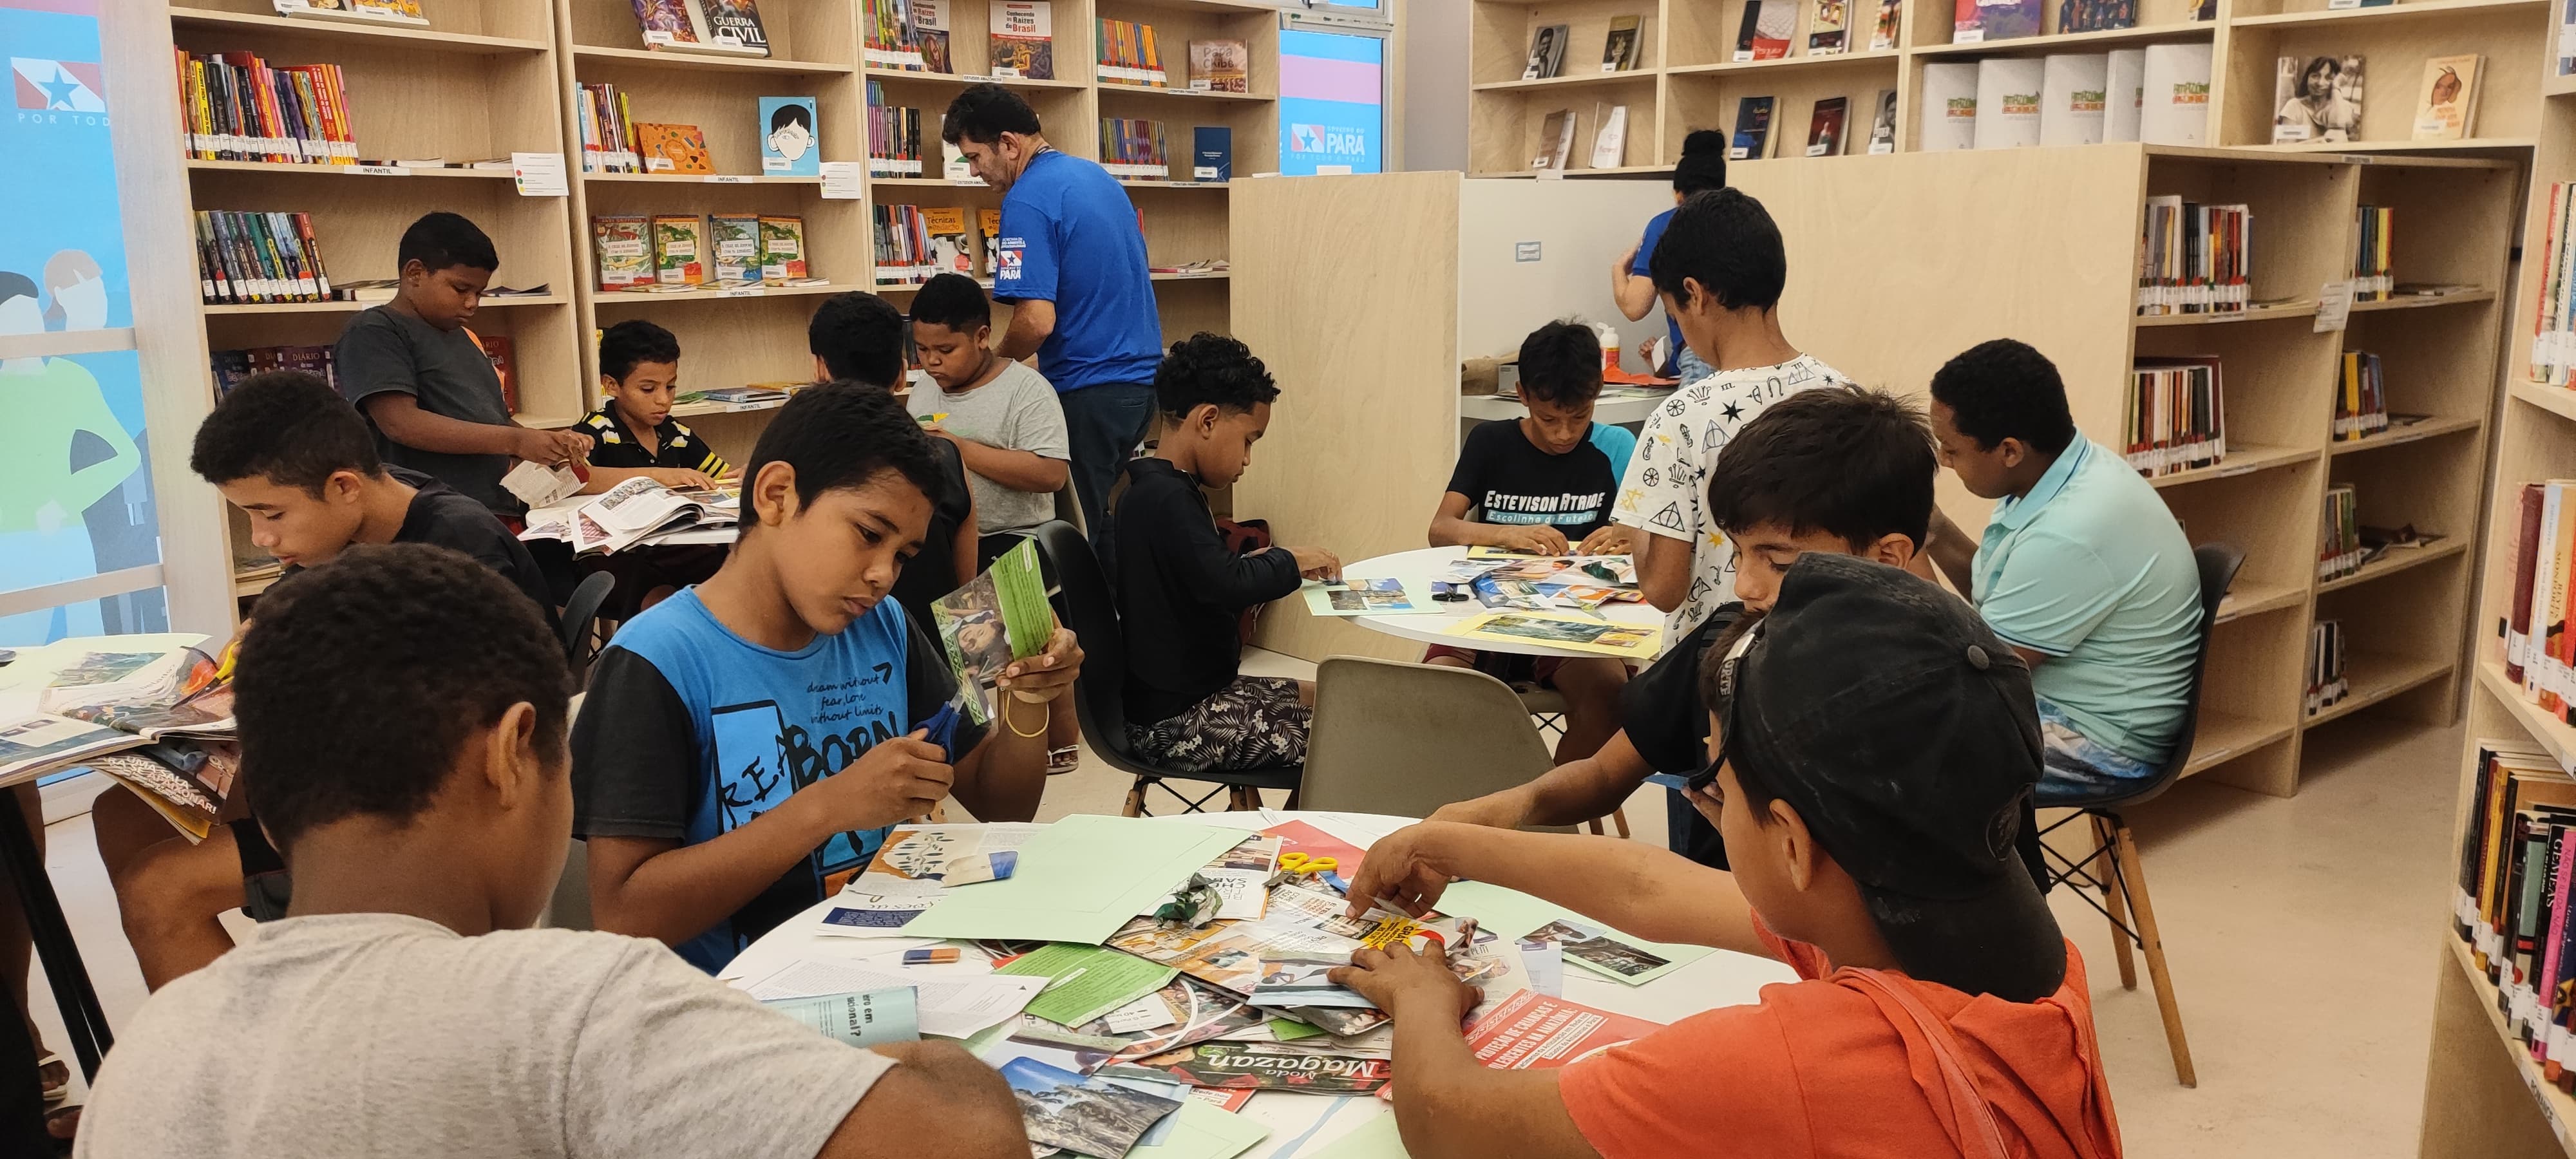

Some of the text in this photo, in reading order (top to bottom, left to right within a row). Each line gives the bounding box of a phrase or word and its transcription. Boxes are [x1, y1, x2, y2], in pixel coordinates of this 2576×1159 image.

[713, 16, 755, 28] GUERRA
[918, 16, 937, 26] Brasil
[718, 26, 766, 44] CIVIL
[1012, 24, 1036, 33] Brasil
[1203, 47, 1233, 59] Papa
[17, 113, 57, 124] POR
[1484, 490, 1558, 513] ESTEVISON
[1488, 510, 1542, 524] Escolinha
[855, 704, 884, 716] limits
[126, 755, 156, 773] UMA
[160, 769, 189, 790] SALA
[864, 1008, 873, 1024] em
[1513, 1005, 1553, 1030] CRIANÇAS
[1504, 1027, 1525, 1038] DE
[1526, 1032, 1545, 1042] NA
[1473, 1033, 1516, 1060] PROTEÇÃO
[1208, 1054, 1380, 1078] Magazan
